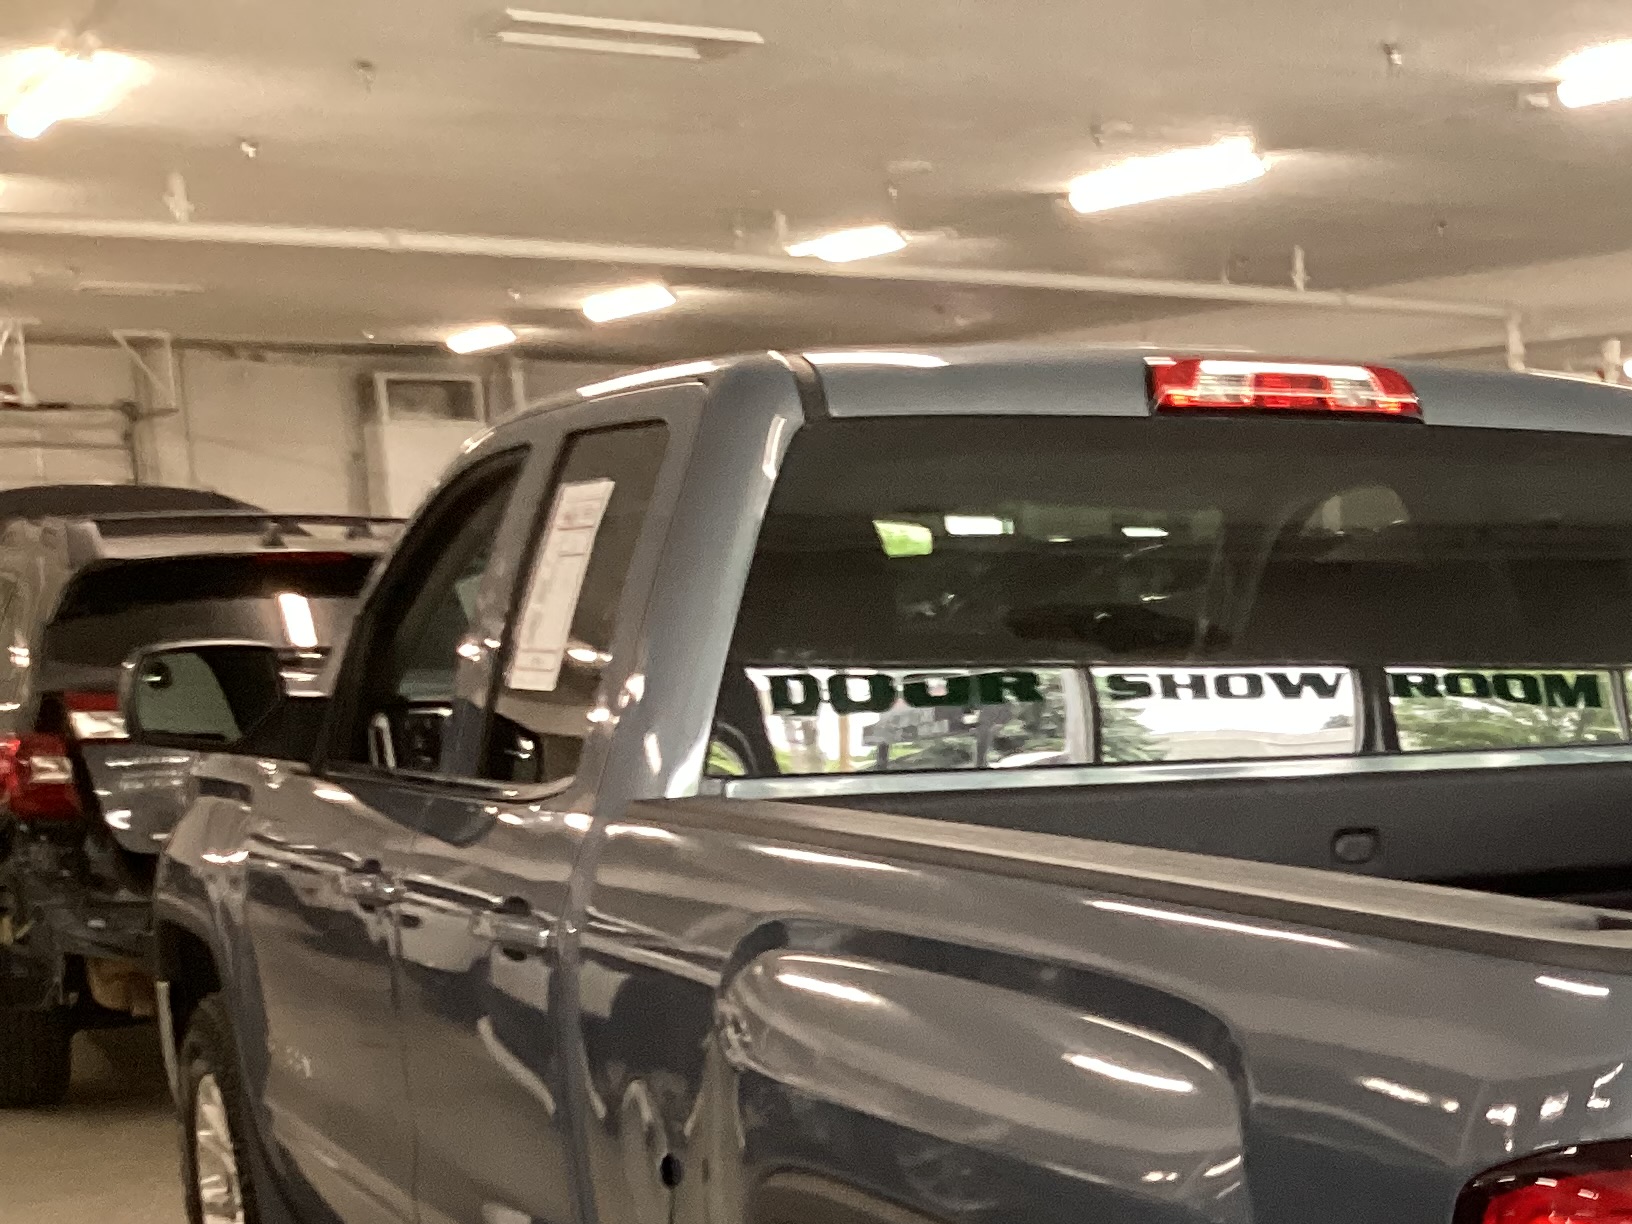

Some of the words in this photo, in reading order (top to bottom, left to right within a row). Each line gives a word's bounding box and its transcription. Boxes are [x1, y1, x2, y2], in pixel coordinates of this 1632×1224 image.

[769, 671, 1043, 716] DOOR
[1106, 671, 1344, 700] SHOW
[1390, 671, 1602, 708] ROOM
